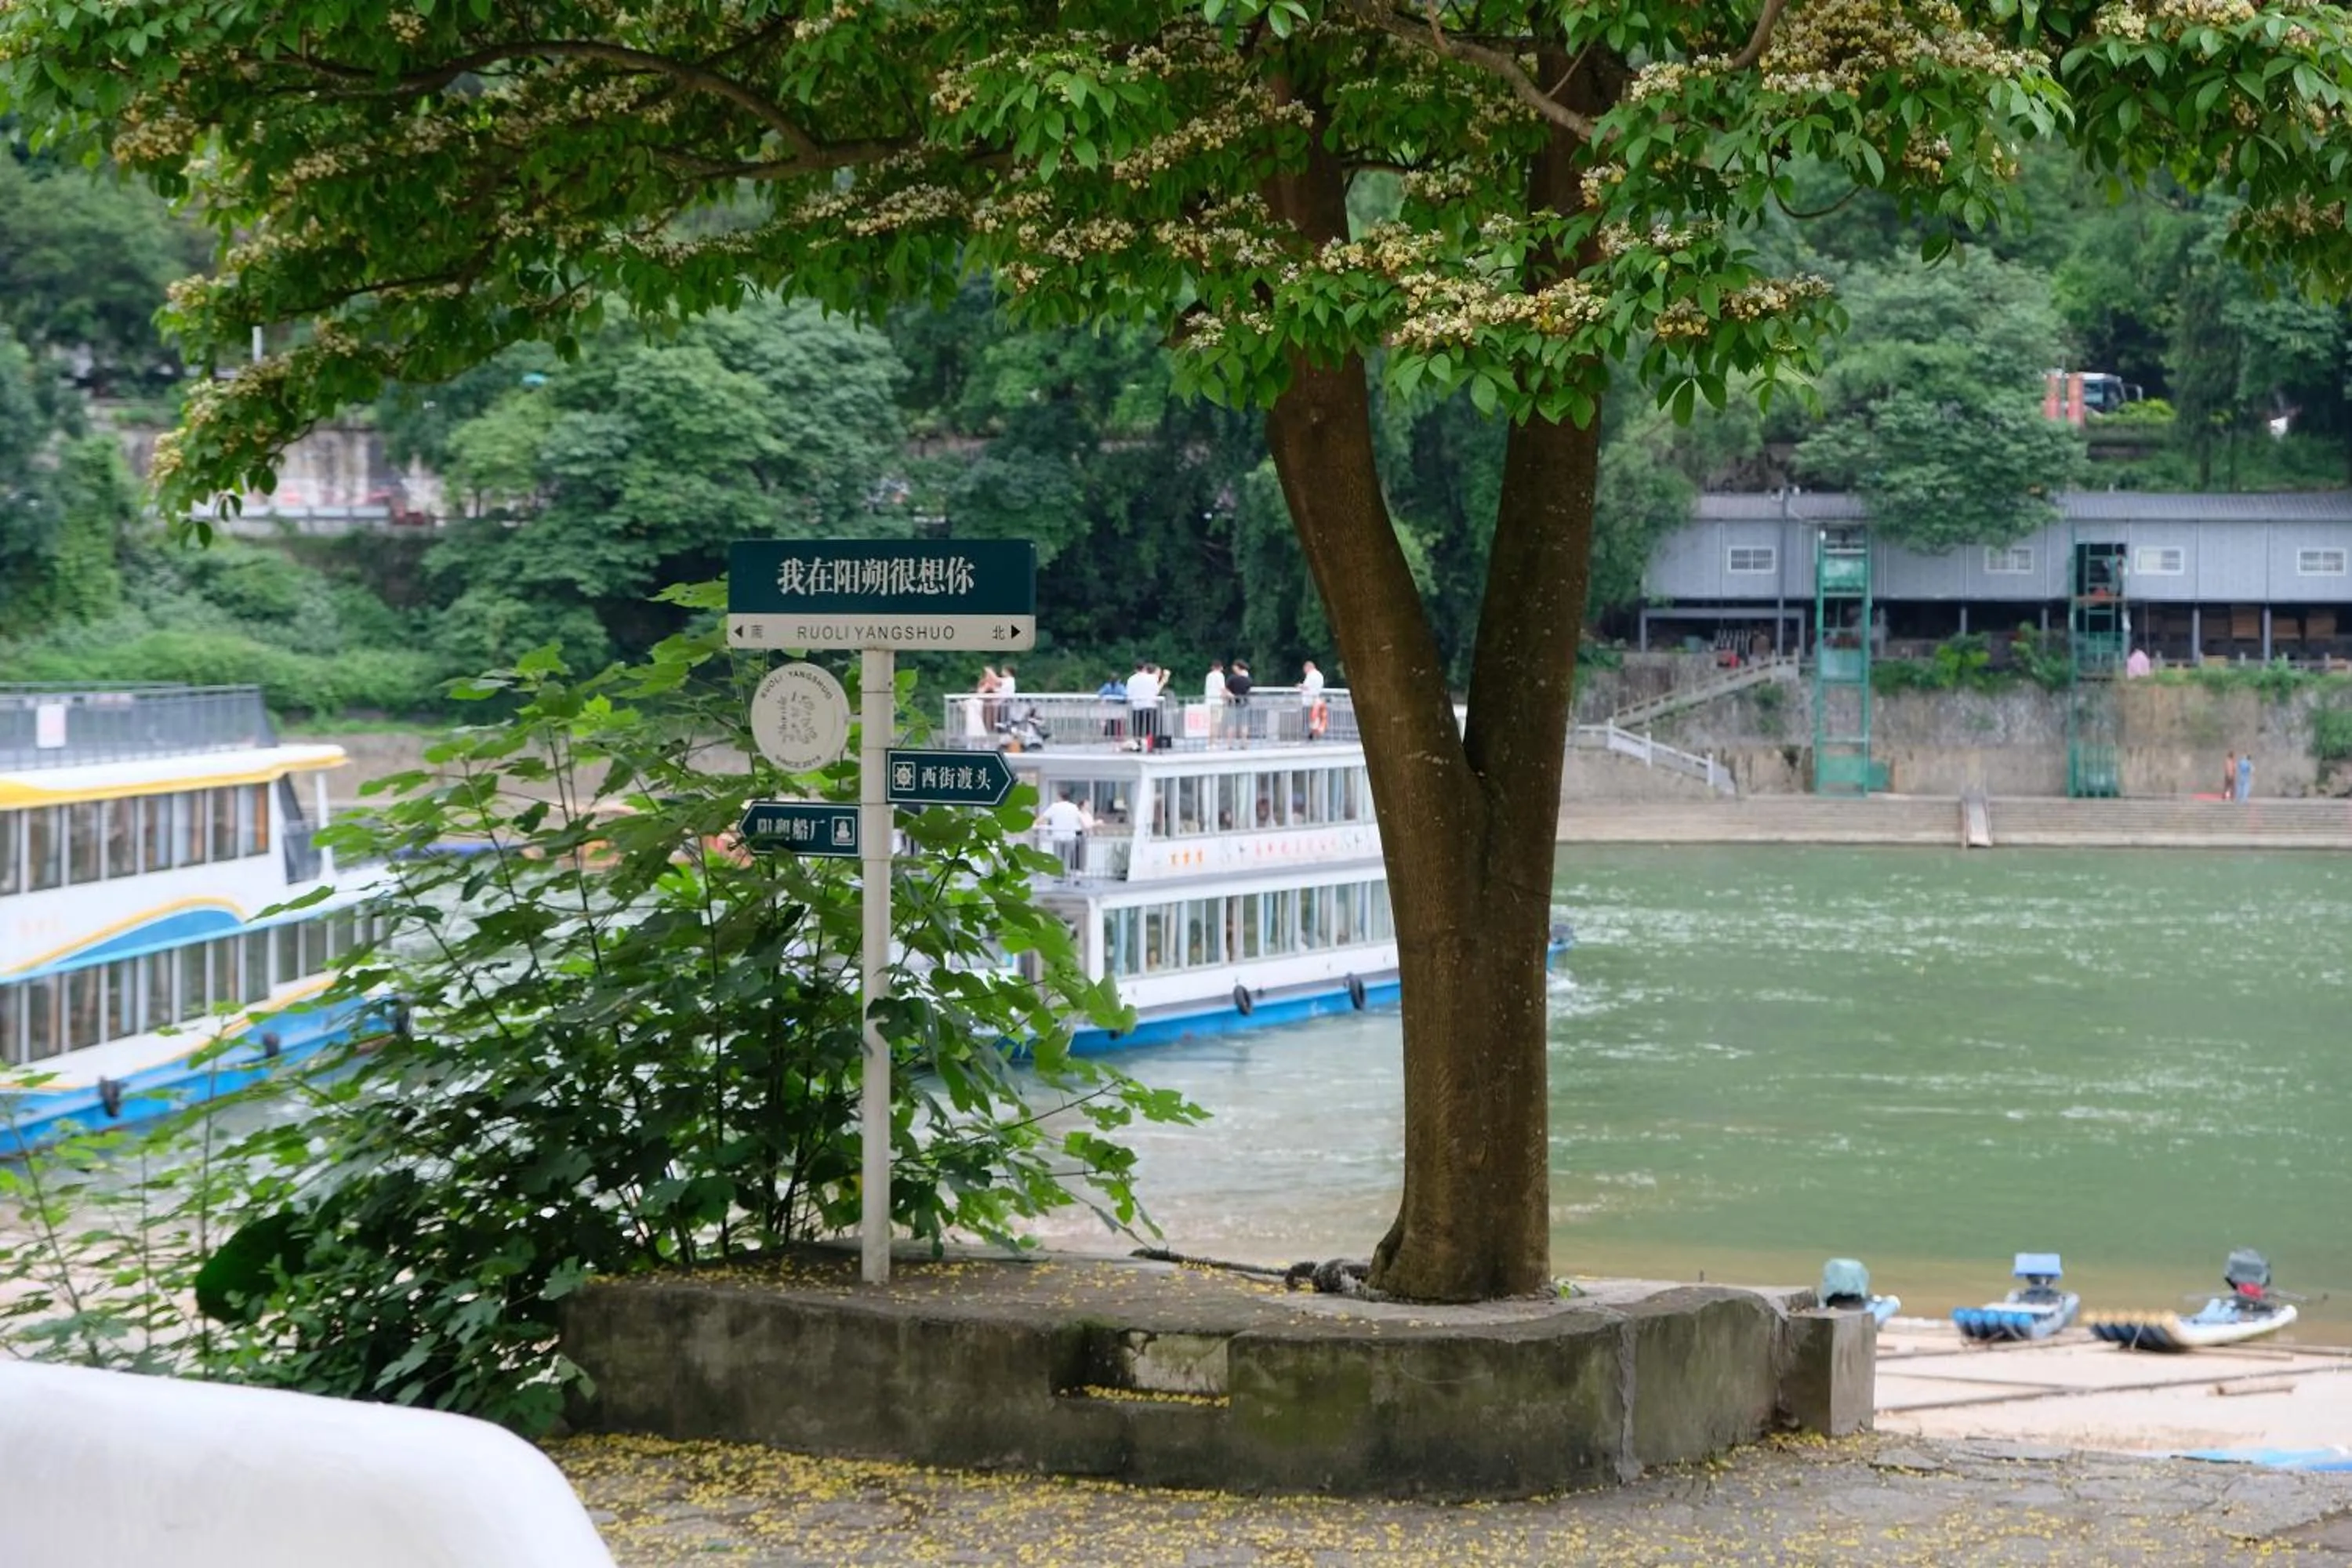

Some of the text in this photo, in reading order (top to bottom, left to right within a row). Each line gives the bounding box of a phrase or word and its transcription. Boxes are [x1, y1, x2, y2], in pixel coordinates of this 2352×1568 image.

[777, 557, 975, 596] 我在阳朔很想你
[797, 625, 955, 641] RUOLI YANGSHUO
[992, 626, 1005, 641] 北
[921, 764, 991, 791] 西街渡头
